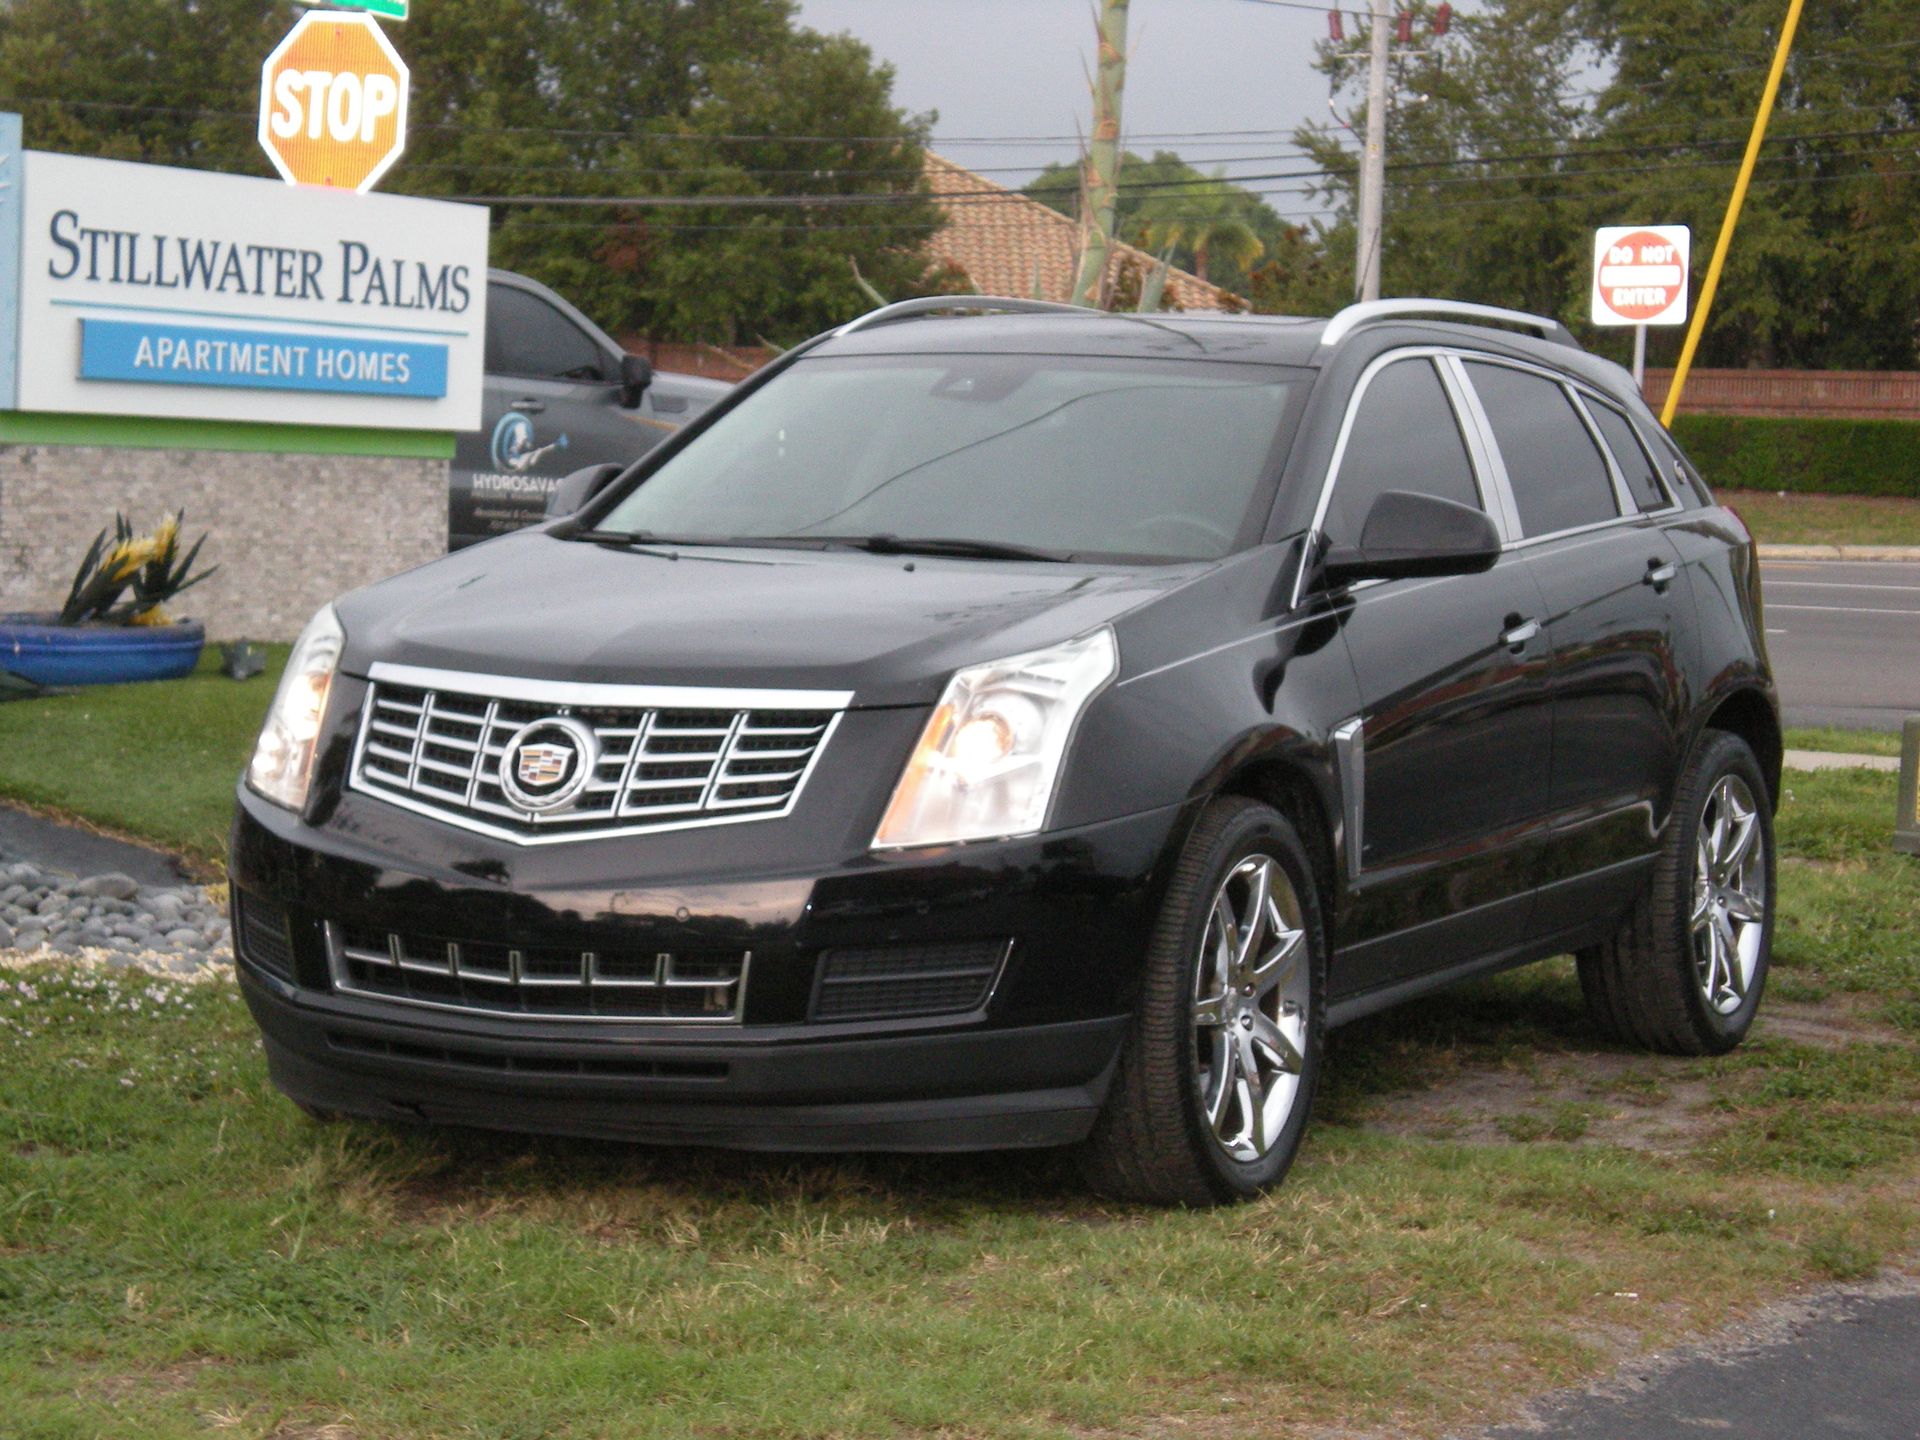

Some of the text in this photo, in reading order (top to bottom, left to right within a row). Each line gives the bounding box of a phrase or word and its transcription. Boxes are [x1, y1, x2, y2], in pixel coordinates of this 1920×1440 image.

[271, 68, 398, 142] STOP
[49, 209, 470, 314] STILLWATER PALMS
[1609, 245, 1675, 264] DO NOT
[1612, 287, 1667, 306] ENTER
[134, 336, 411, 384] APARTMENT HOMES
